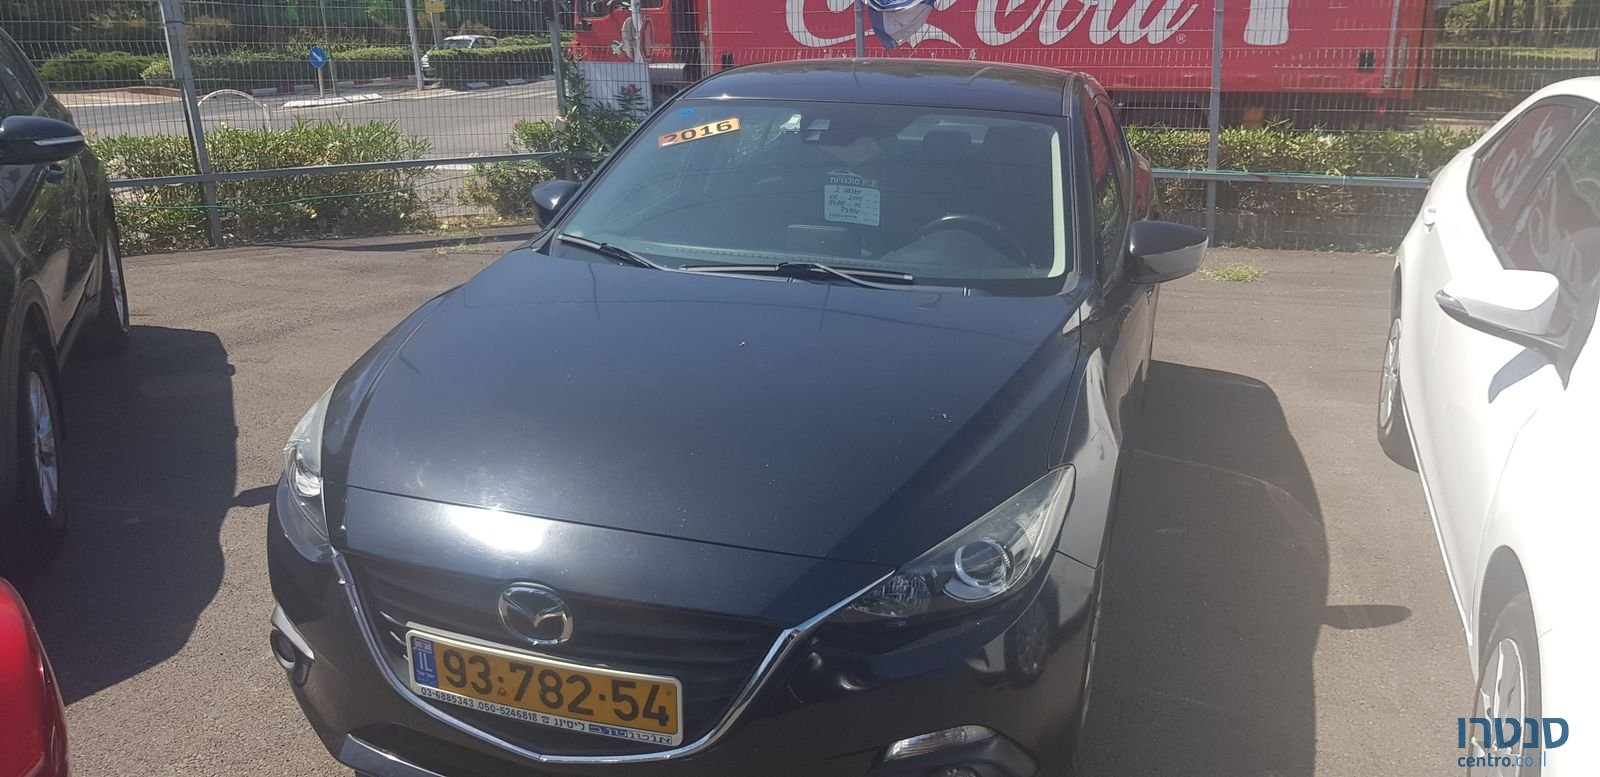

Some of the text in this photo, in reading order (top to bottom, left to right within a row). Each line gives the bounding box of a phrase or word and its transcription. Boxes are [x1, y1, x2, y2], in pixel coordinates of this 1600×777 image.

[663, 120, 732, 143] 2016
[419, 651, 433, 672] IL
[421, 687, 474, 708] 03-6885343
